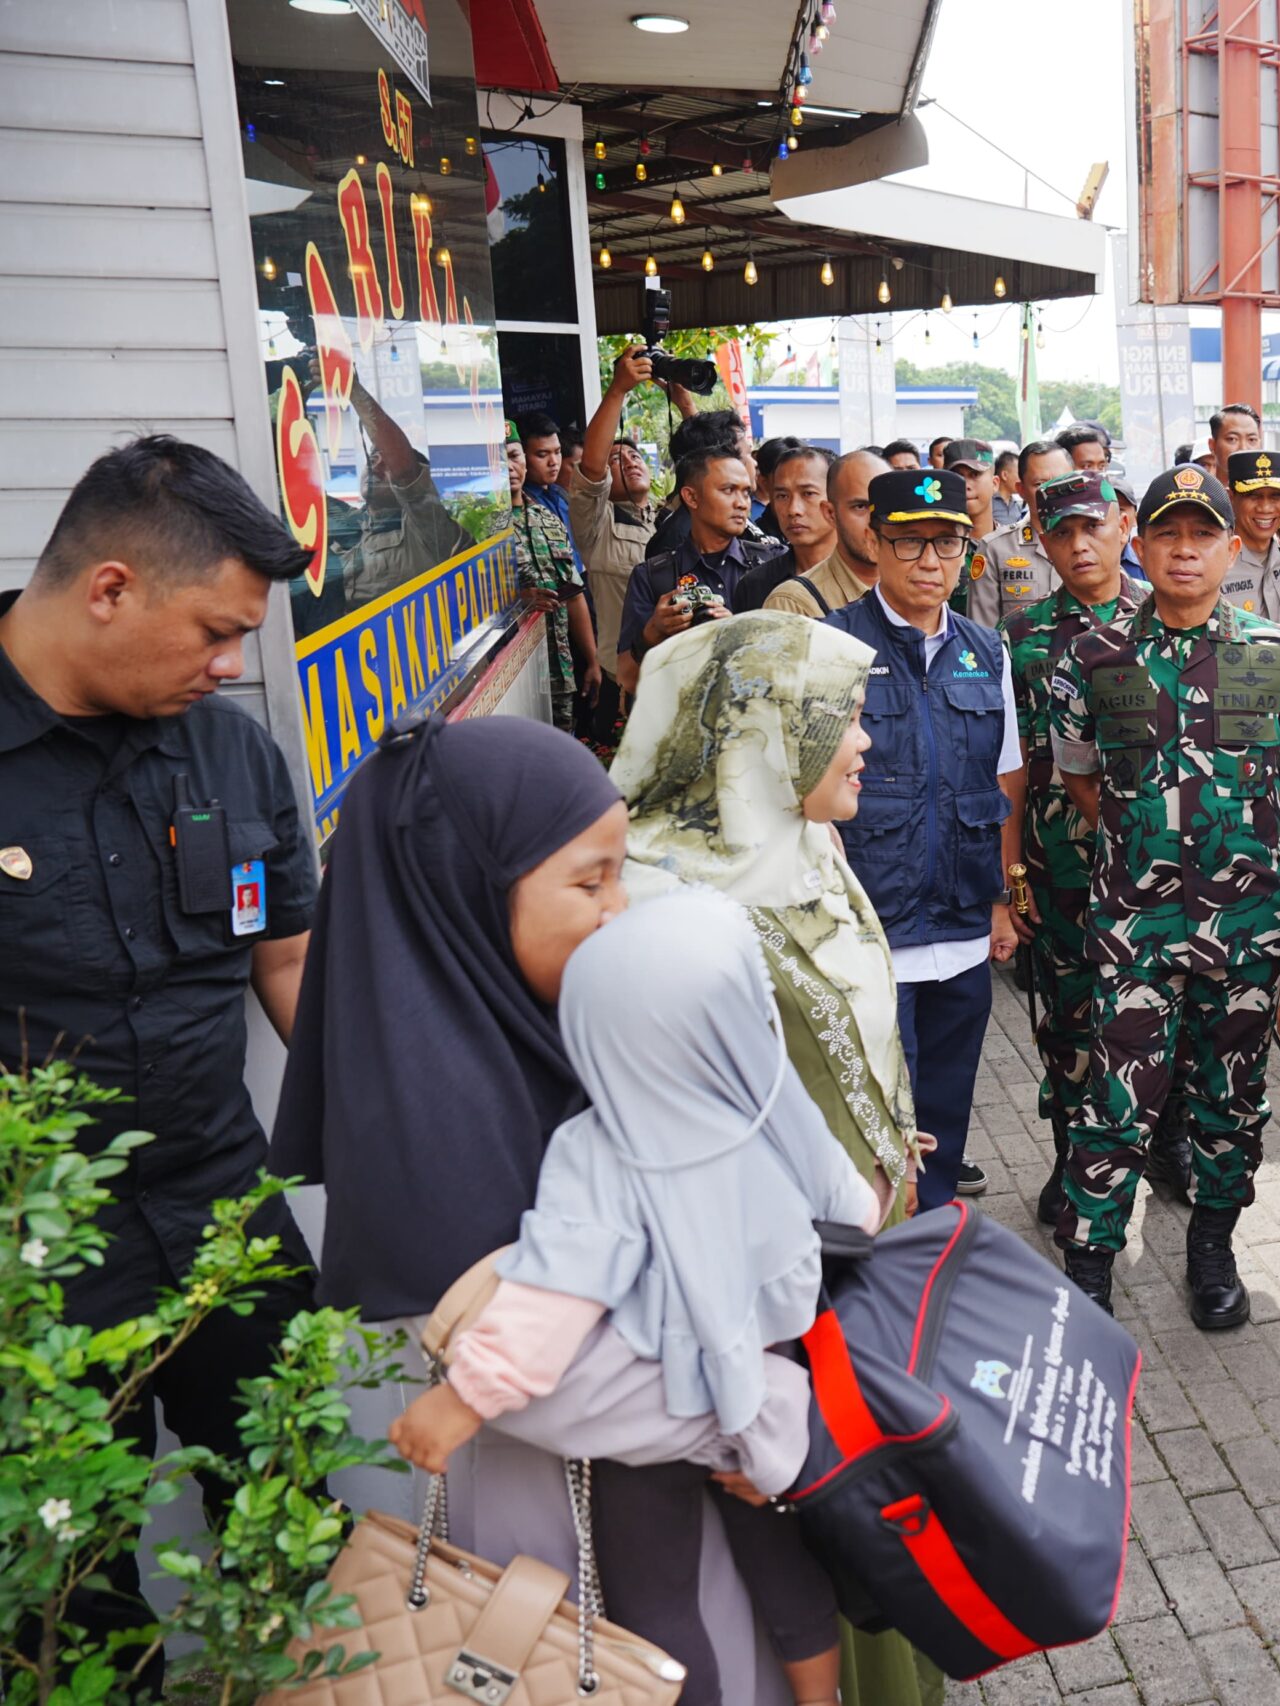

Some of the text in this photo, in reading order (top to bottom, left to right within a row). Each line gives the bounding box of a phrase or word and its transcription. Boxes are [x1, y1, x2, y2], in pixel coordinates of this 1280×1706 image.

[1003, 570, 1033, 580] FERLI
[298, 543, 517, 799] MASAKAN PADANG
[953, 670, 989, 678] Kemenkes
[1100, 694, 1146, 710] AGUS
[1218, 692, 1277, 709] TNI AD
